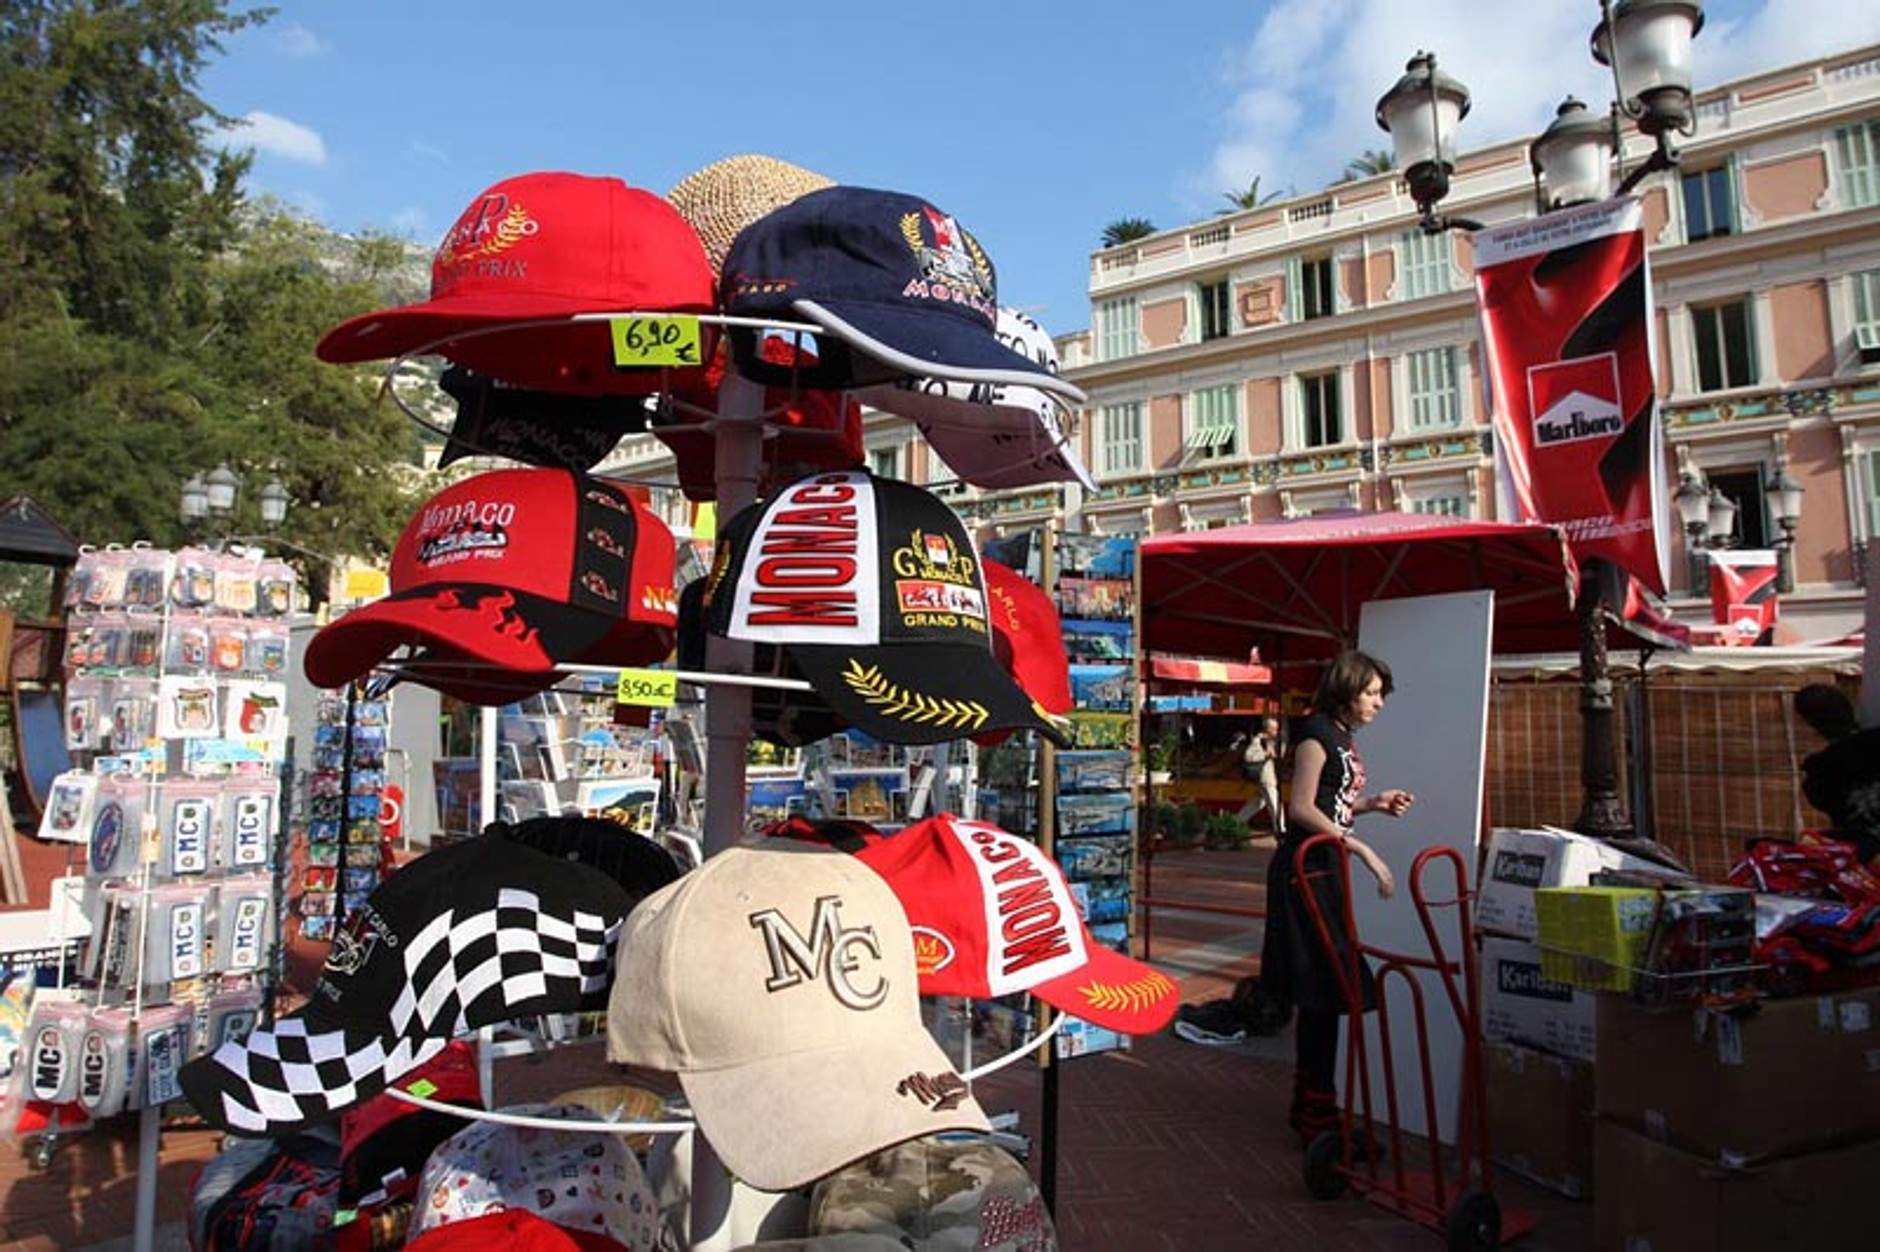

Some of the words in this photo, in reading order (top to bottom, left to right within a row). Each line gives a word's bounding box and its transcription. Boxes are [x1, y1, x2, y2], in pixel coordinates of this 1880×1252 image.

[1536, 410, 1622, 443] Marlboro
[904, 614, 958, 628] GRAND
[178, 819, 200, 853] MC
[239, 816, 260, 846] MC
[175, 923, 196, 958] MC
[236, 918, 256, 948] MC
[35, 1047, 61, 1090] MC
[83, 1052, 104, 1098] MC
